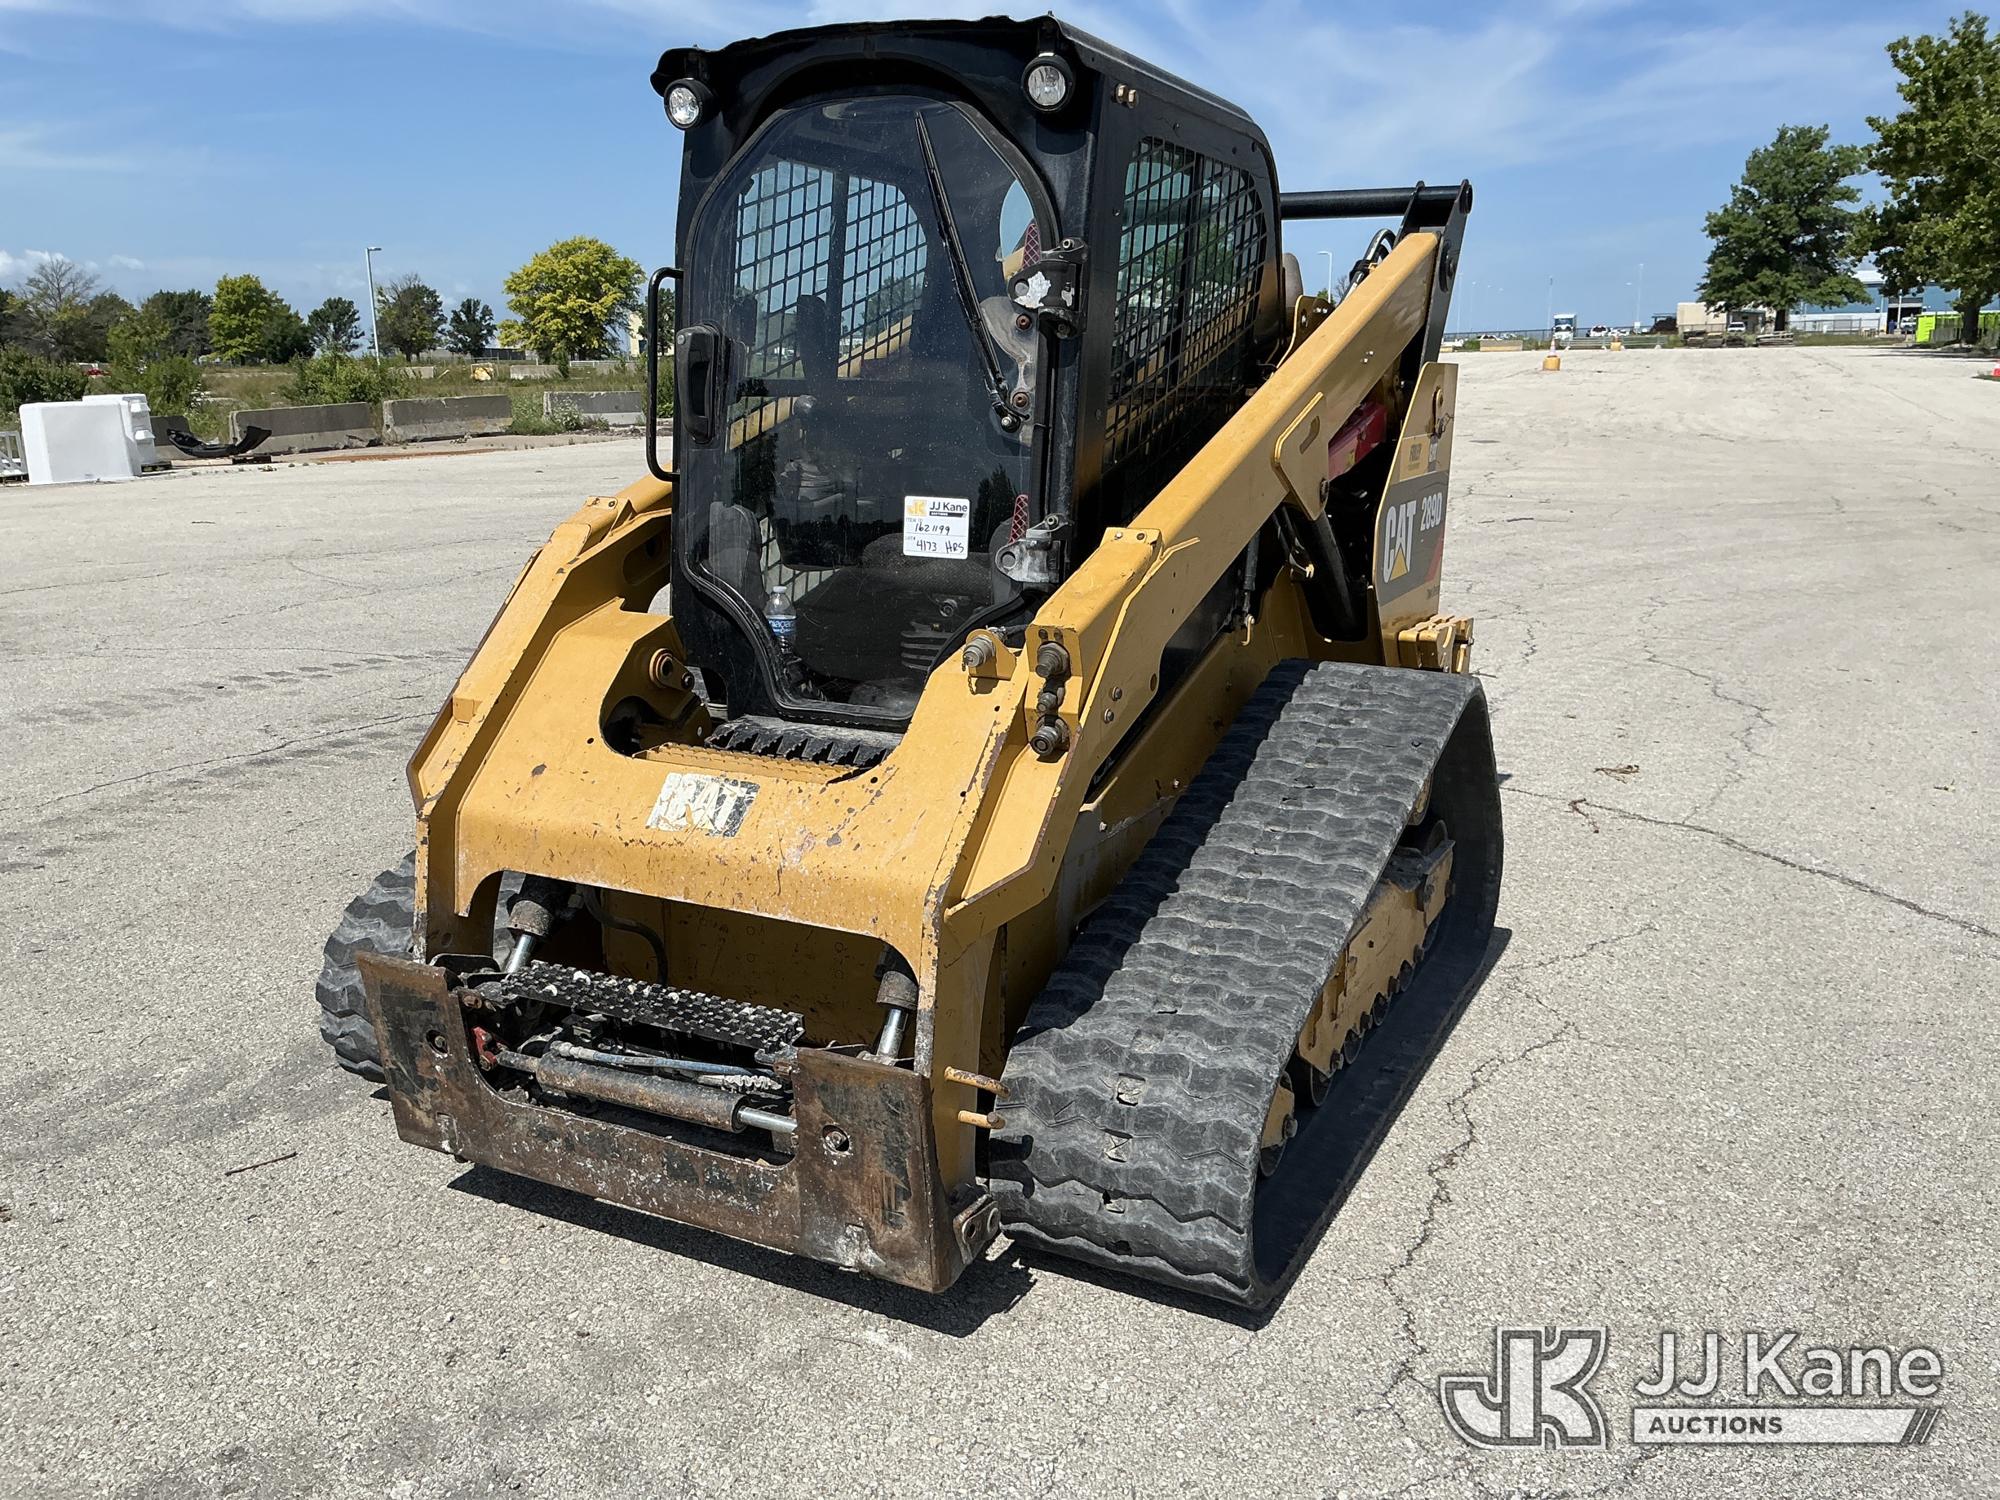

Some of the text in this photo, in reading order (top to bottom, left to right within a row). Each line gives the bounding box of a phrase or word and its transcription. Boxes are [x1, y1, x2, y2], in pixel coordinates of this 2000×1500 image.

[929, 501, 968, 512] JJ Kane
[1420, 492, 1443, 532] 289D
[916, 540, 964, 554] 4173 HRS
[1383, 500, 1417, 584] CAT
